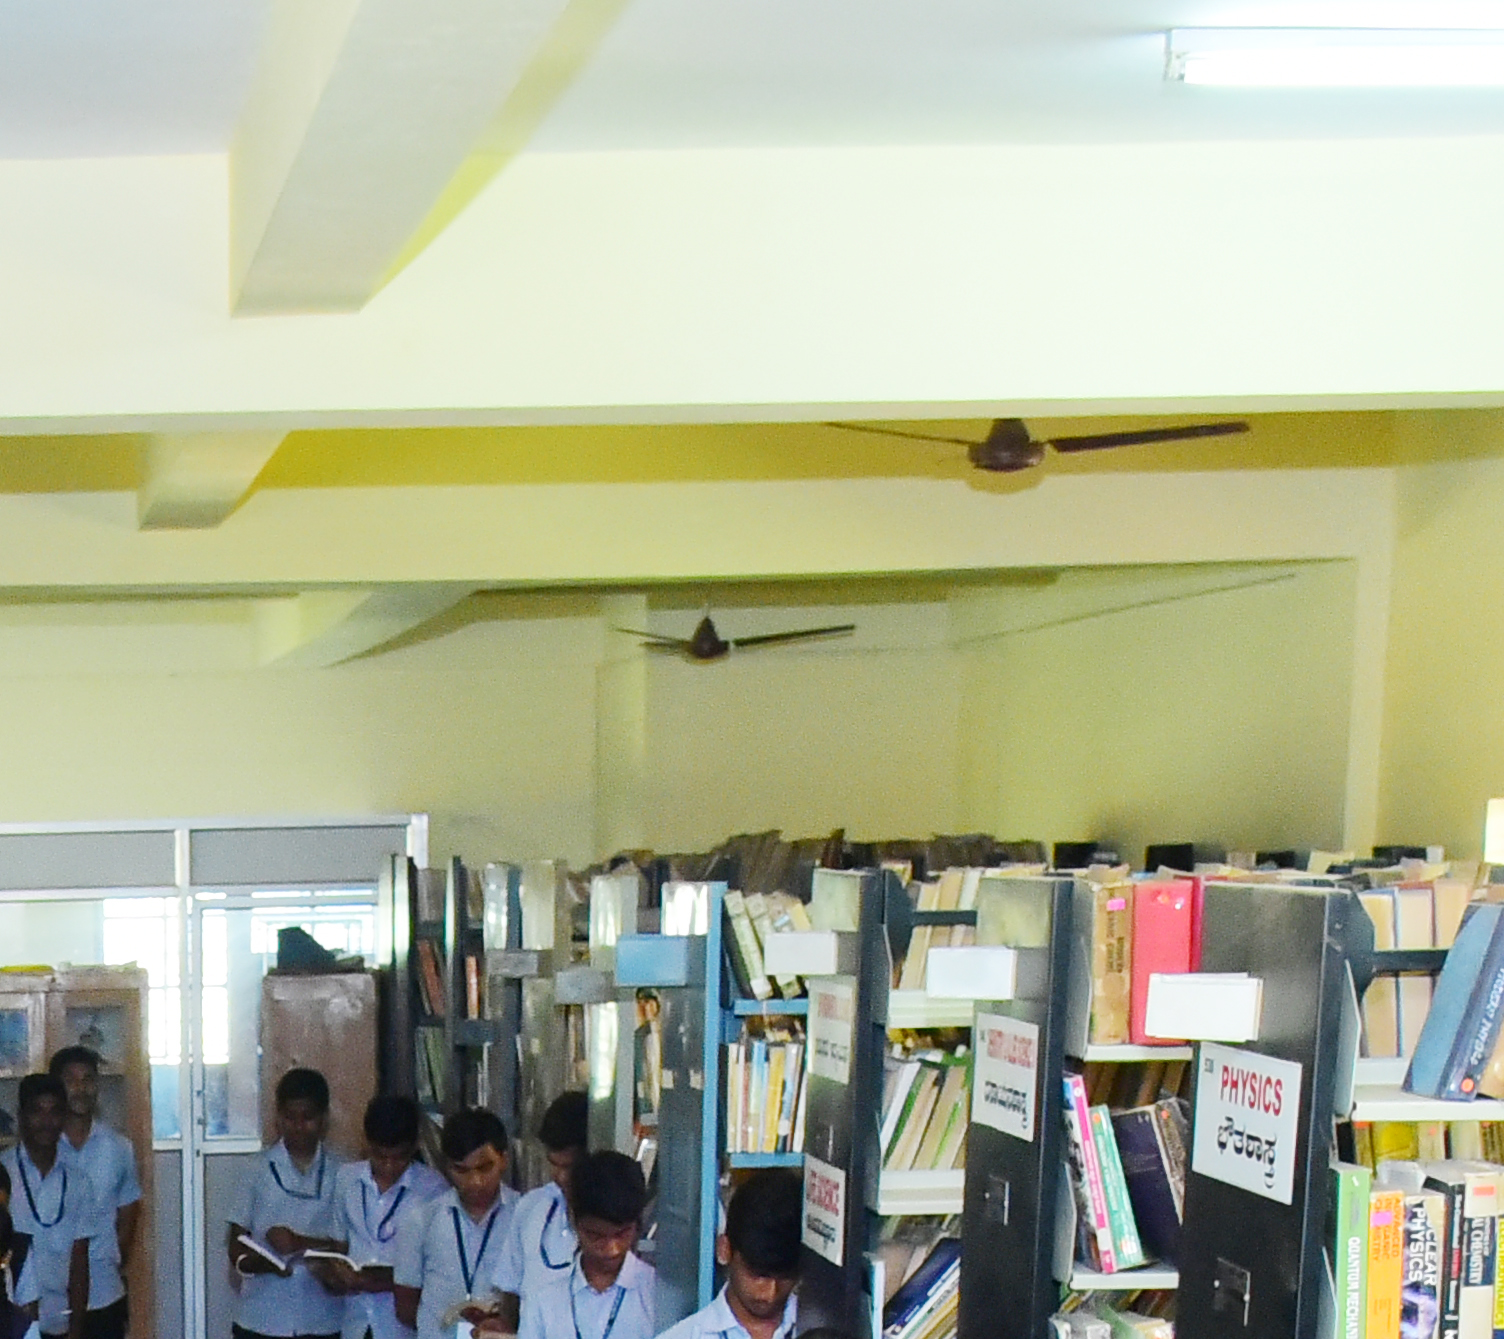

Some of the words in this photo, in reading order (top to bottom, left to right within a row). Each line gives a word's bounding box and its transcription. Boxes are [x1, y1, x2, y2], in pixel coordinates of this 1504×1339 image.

[1220, 1065, 1283, 1116] PHYSICS
[1348, 1237, 1360, 1290] QUANTUM
[1408, 1207, 1426, 1283] PHYSICS
[1423, 1220, 1437, 1287] CLEAR
